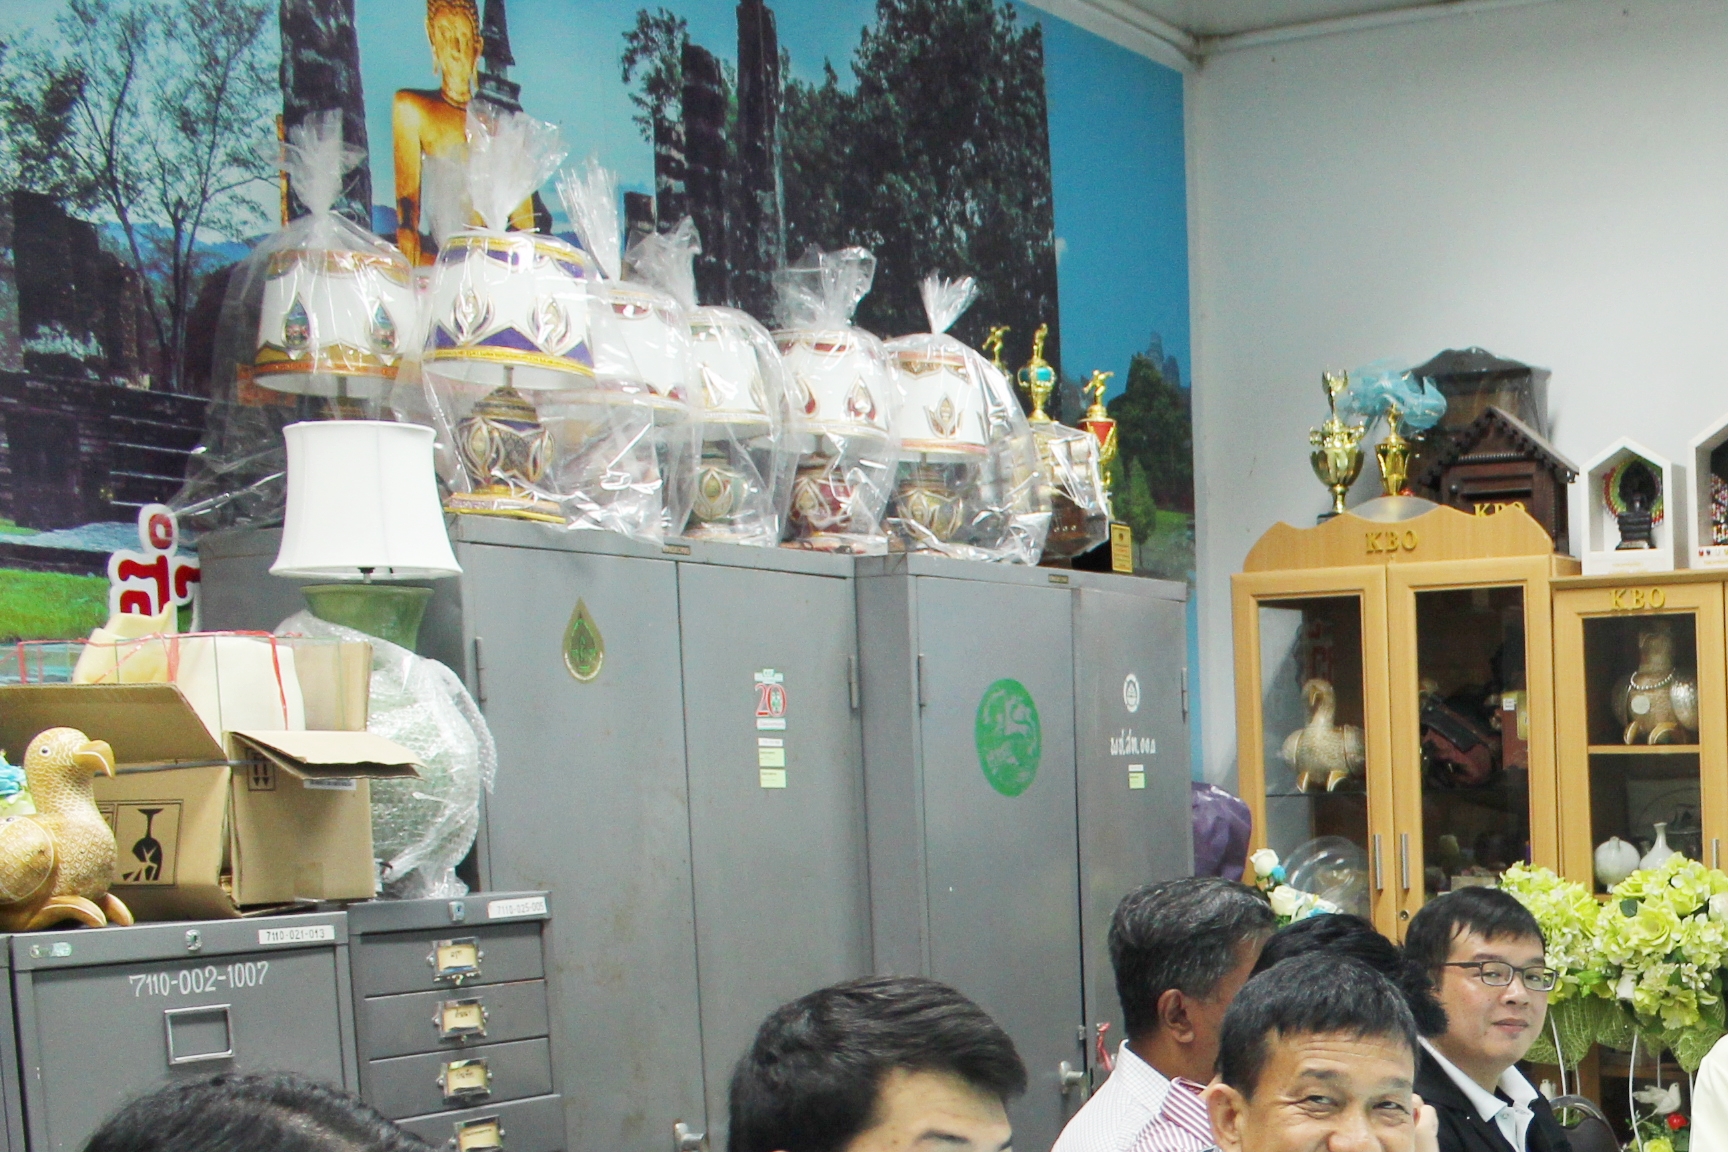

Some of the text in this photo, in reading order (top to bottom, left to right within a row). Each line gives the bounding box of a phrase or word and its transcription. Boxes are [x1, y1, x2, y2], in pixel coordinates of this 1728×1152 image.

[1366, 530, 1419, 553] KBO
[1609, 588, 1666, 611] KBO
[265, 928, 326, 942] 7110-021-013
[129, 961, 270, 998] 7110-002-1007
